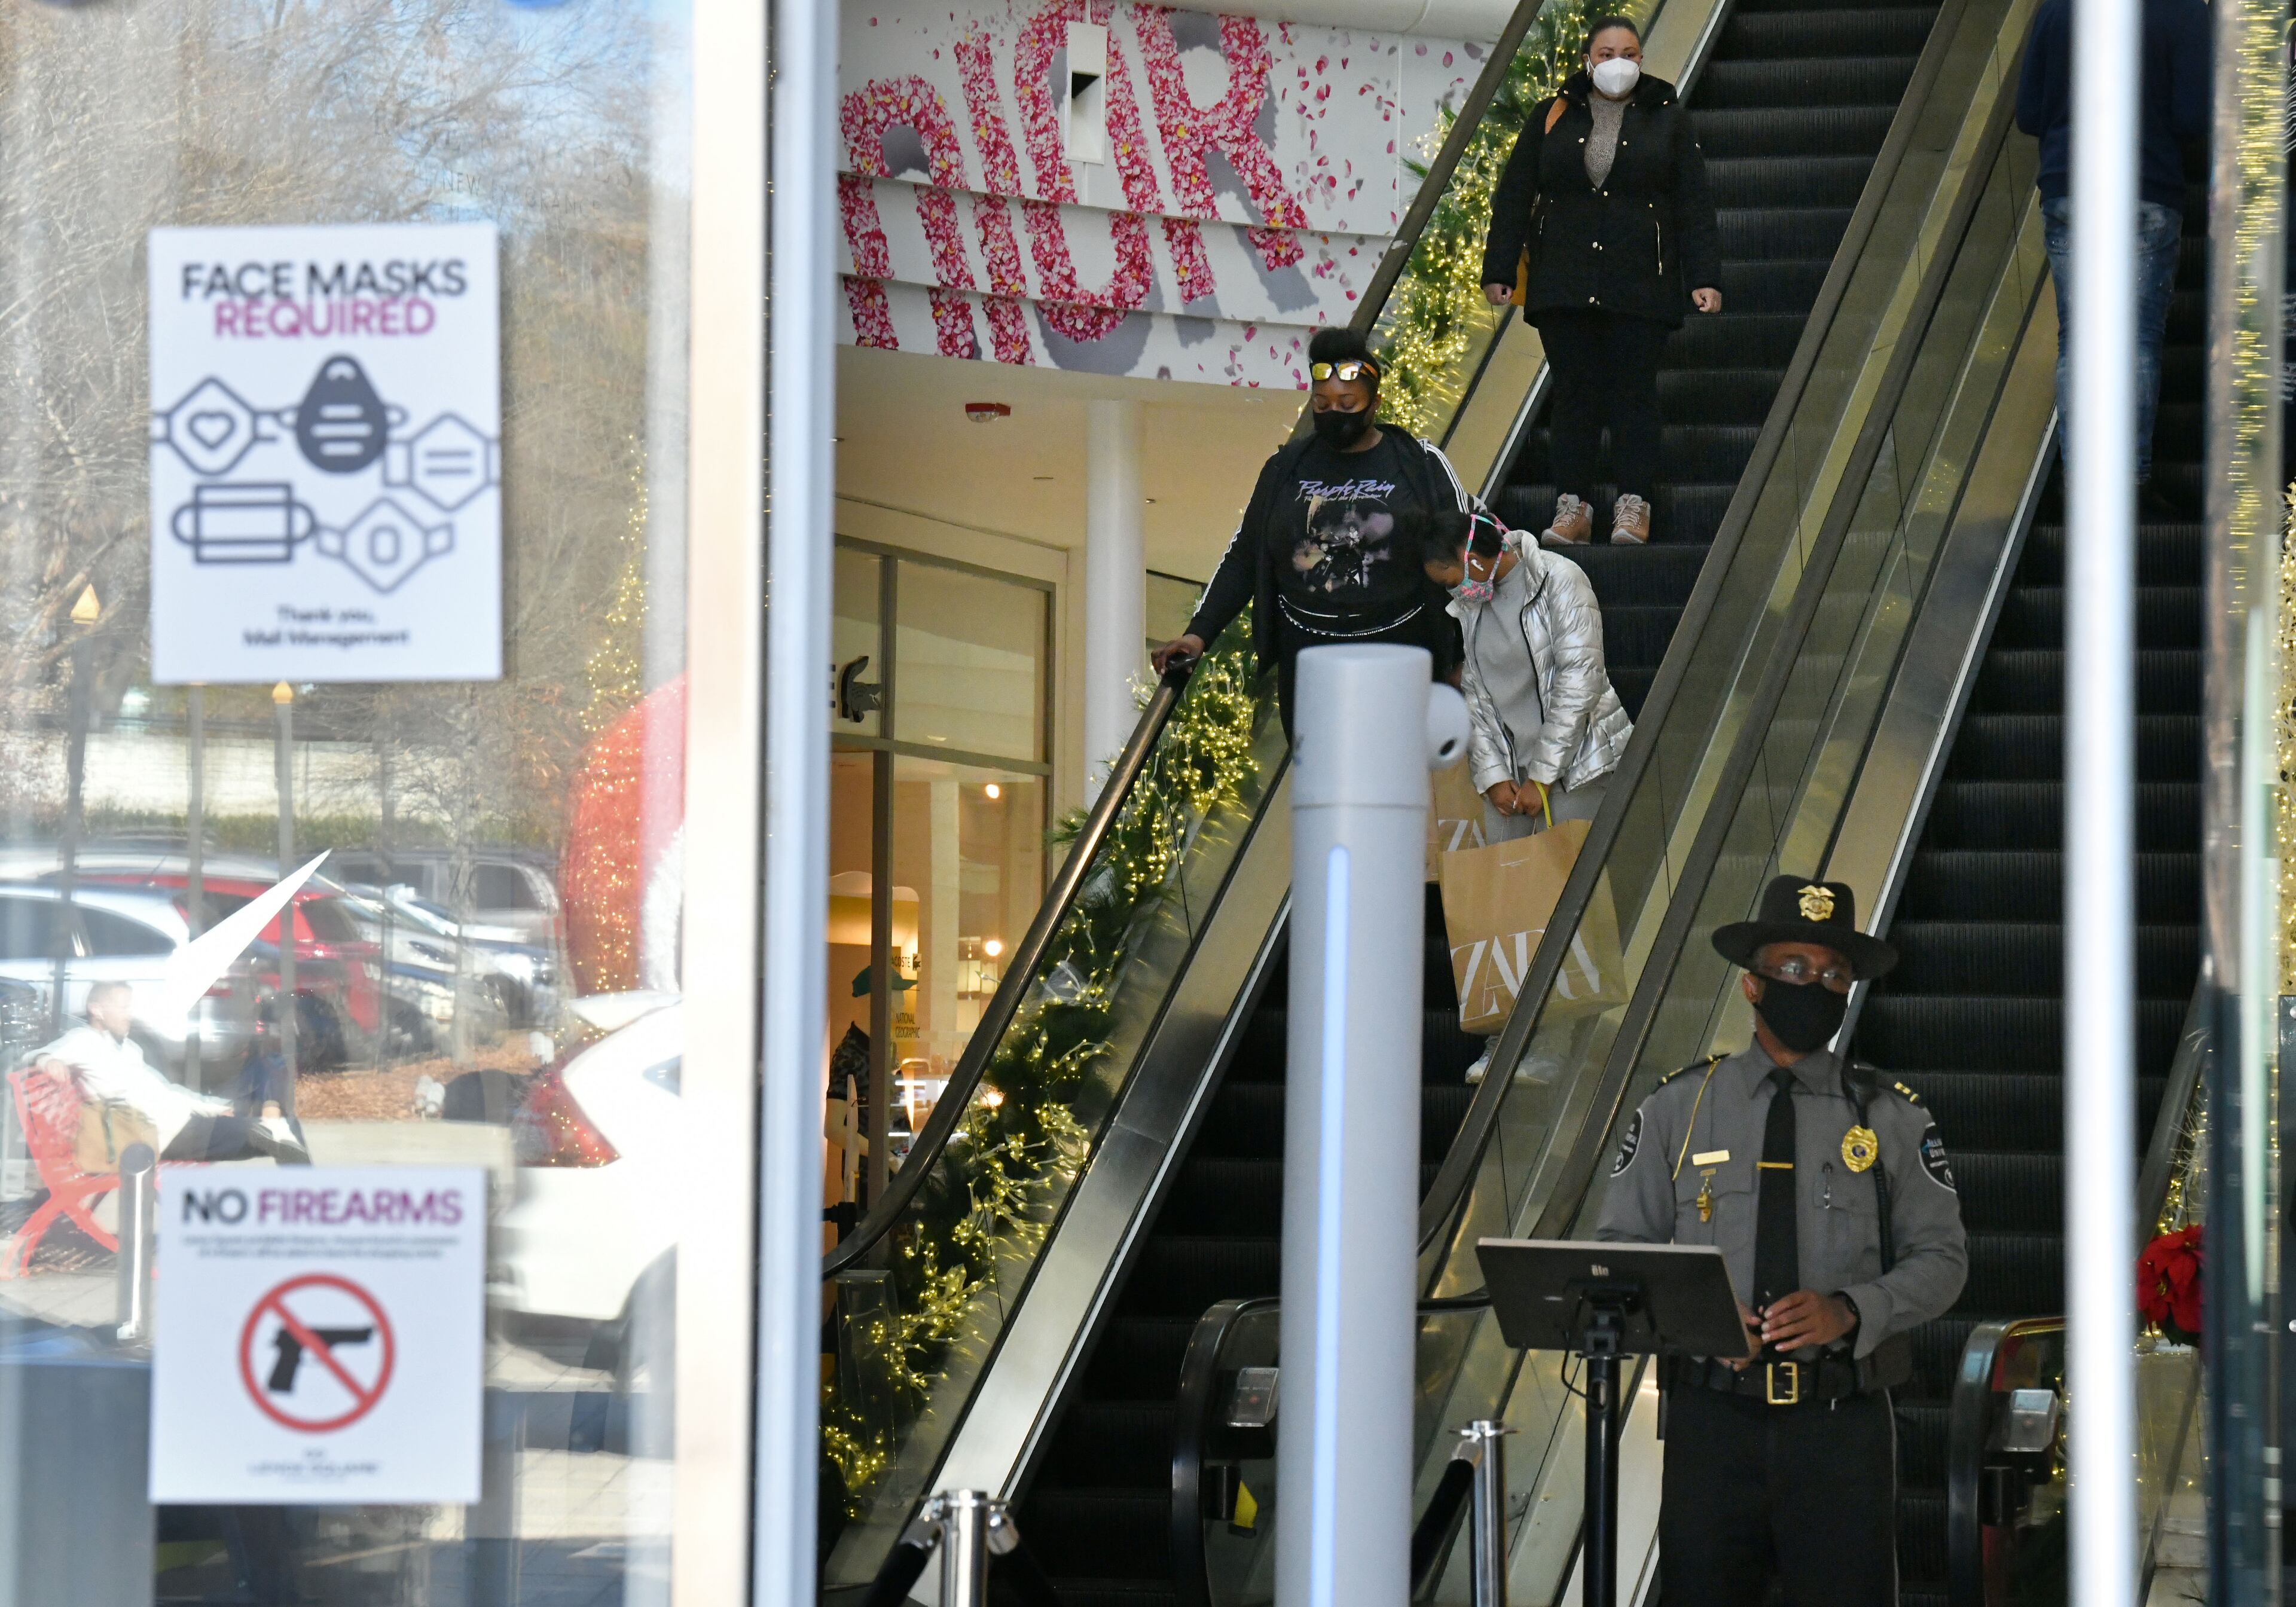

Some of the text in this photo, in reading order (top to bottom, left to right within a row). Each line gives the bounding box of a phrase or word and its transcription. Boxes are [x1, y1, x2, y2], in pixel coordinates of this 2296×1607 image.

[182, 259, 468, 299] FACE MASKS
[215, 298, 436, 337] REQUIRED
[1295, 478, 1396, 506] Purple Rain
[277, 604, 330, 621] Thank
[243, 628, 408, 650] Mall Management
[1450, 929, 1600, 1022] ZARA
[895, 1026, 920, 1038] GEOGRAPHIC
[896, 1012, 915, 1024] NATIONAL
[182, 1189, 464, 1225] NO FIREARMS
